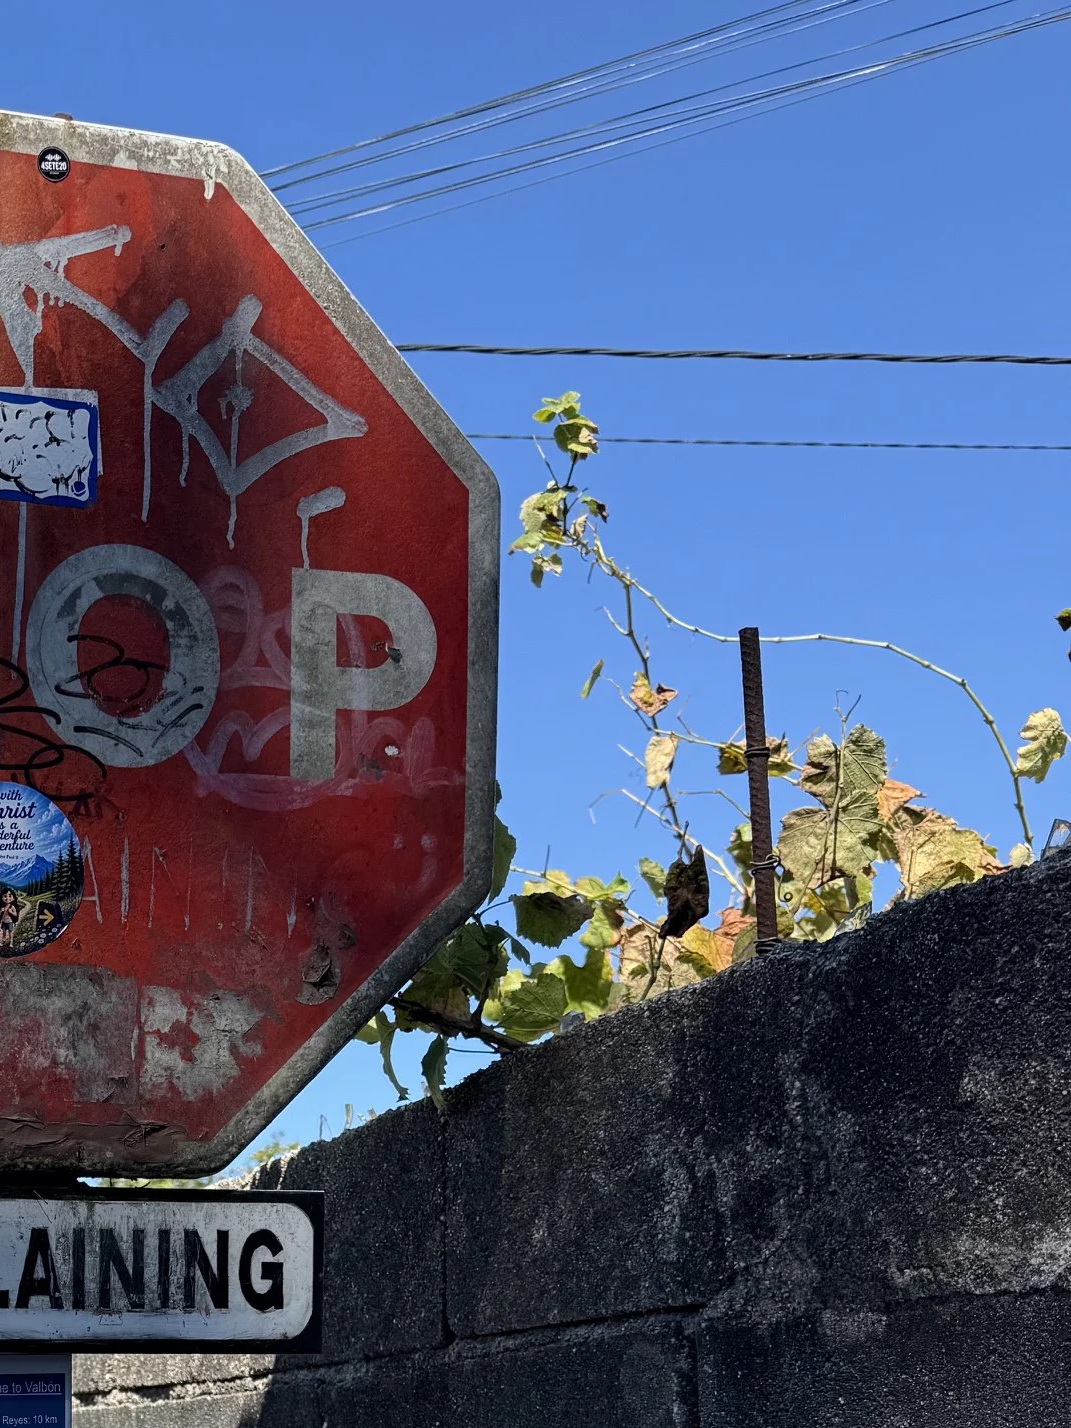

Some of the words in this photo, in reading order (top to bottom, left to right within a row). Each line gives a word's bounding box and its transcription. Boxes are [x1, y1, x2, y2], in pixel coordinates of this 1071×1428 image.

[10, 822, 18, 830] a
[12, 1382, 22, 1393] to
[2, 1415, 31, 1427] Reyes:
[33, 1415, 43, 1424] 10
[45, 1415, 58, 1424] km
